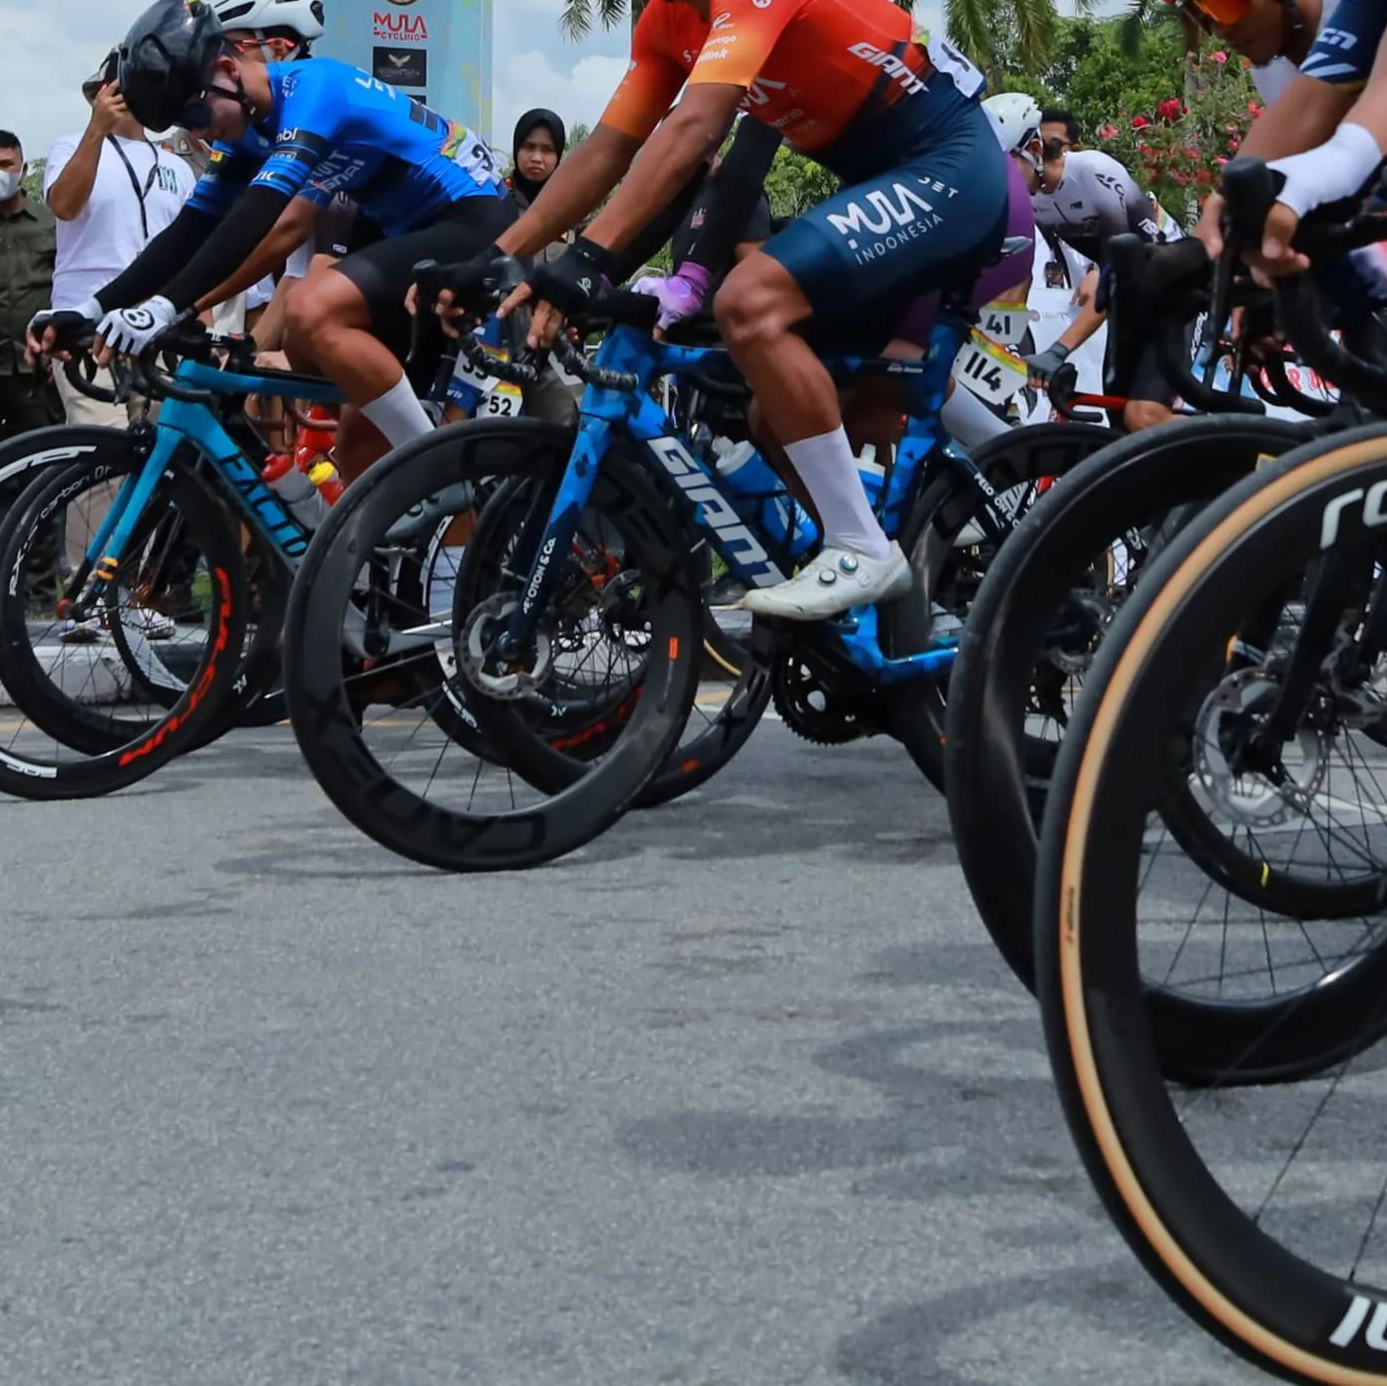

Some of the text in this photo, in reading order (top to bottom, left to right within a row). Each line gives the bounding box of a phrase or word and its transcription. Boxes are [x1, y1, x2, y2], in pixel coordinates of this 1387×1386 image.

[374, 12, 426, 33] MULA
[380, 32, 421, 42] CYCLING
[846, 42, 930, 95] GIANT
[917, 176, 959, 199] JET
[826, 182, 934, 236] MULA
[854, 213, 944, 265] INDONESIA
[985, 314, 1011, 335] 41
[964, 351, 1002, 393] 114
[489, 396, 513, 416] 52
[647, 435, 791, 588] GIANT
[540, 555, 550, 565] &
